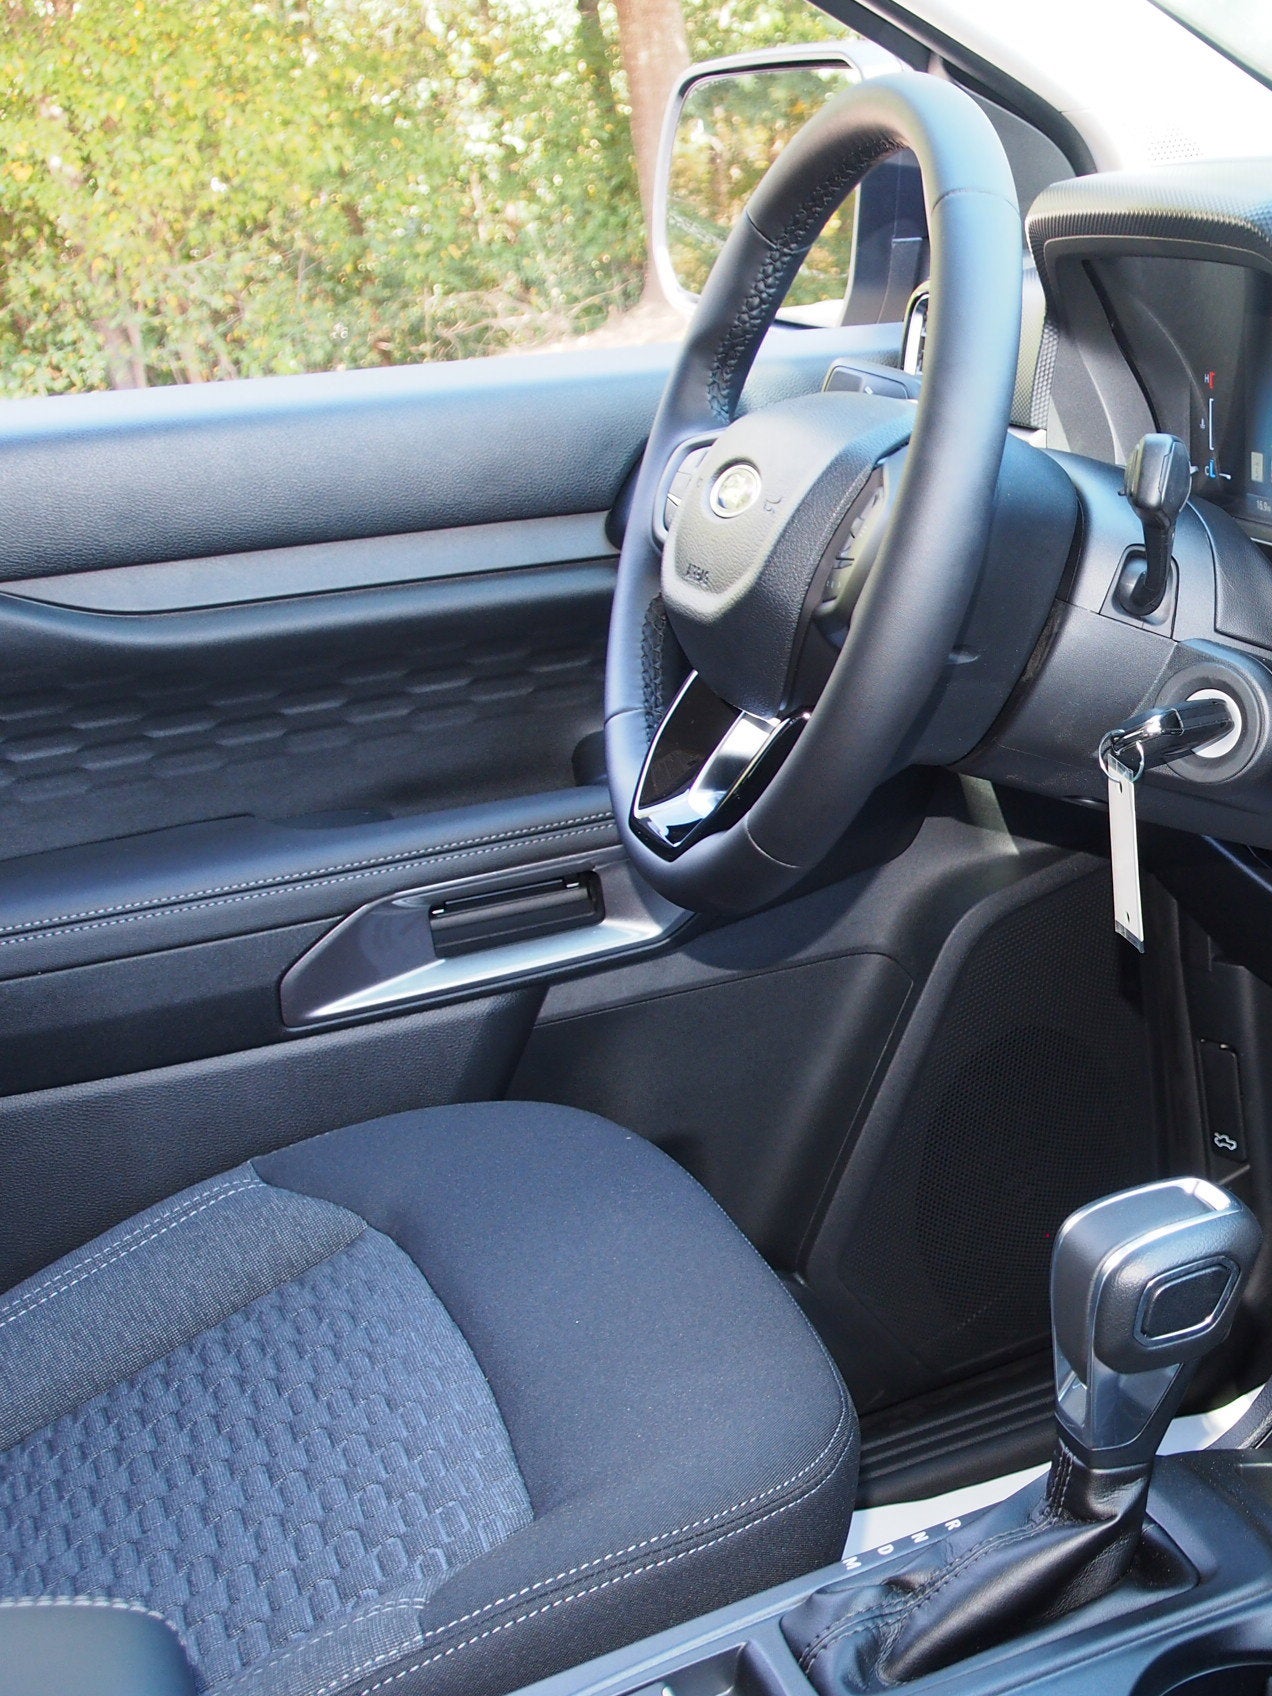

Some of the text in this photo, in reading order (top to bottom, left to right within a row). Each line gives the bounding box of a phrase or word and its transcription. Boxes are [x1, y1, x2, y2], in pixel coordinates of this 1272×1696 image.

[1204, 374, 1210, 383] H
[945, 1519, 961, 1531] R
[911, 1531, 929, 1544] N
[877, 1544, 894, 1555] D
[841, 1555, 862, 1571] M
